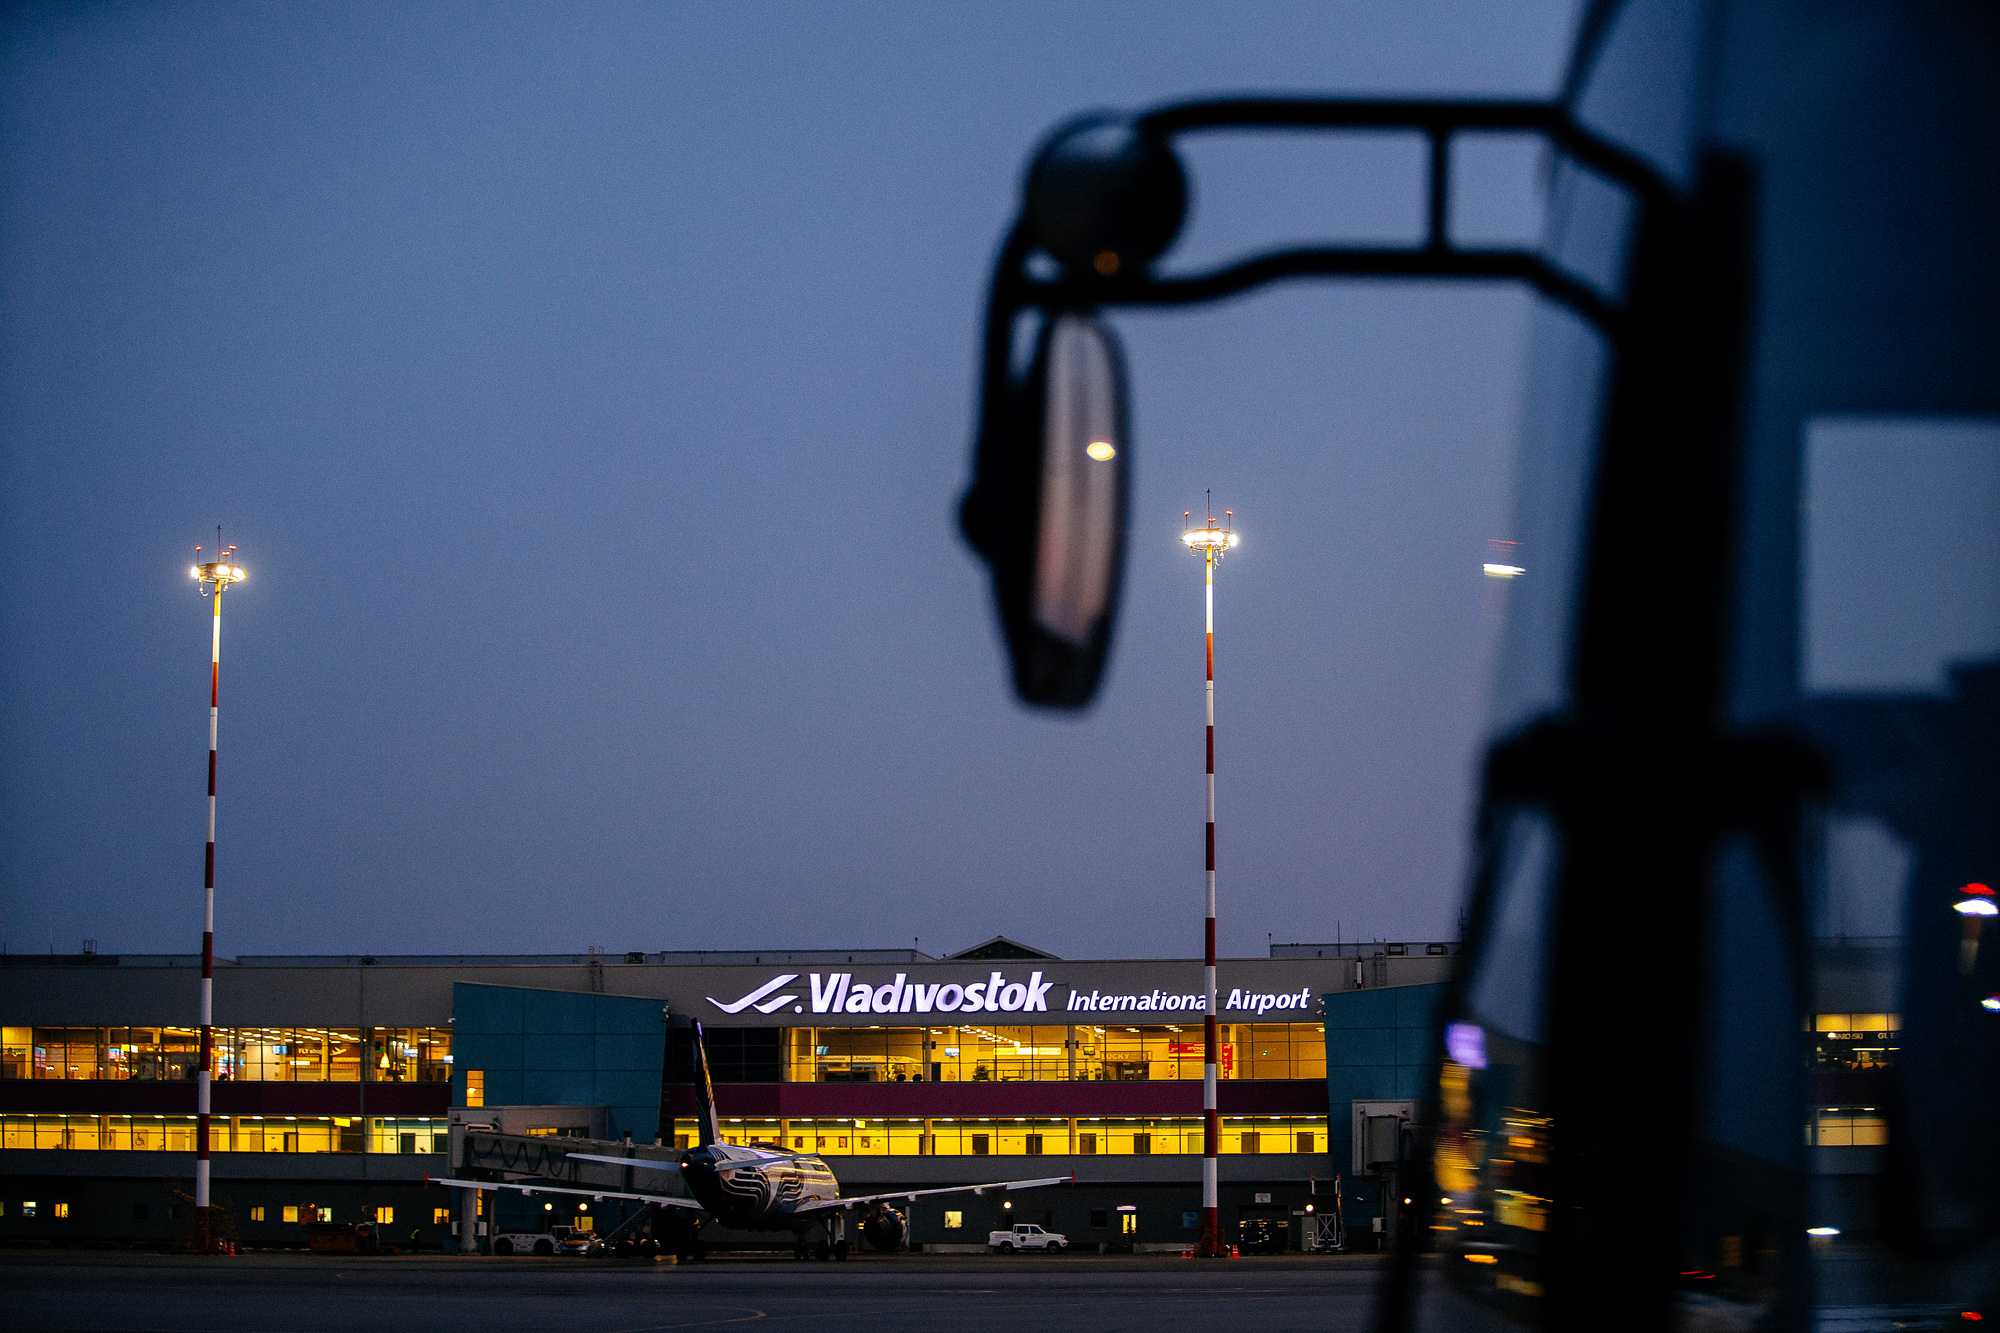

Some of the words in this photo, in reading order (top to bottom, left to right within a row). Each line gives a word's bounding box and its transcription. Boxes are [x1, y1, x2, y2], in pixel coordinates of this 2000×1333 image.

[809, 971, 1054, 1014] Vladivostok
[1066, 989, 1218, 1011] Internationa
[1225, 987, 1310, 1015] Airport
